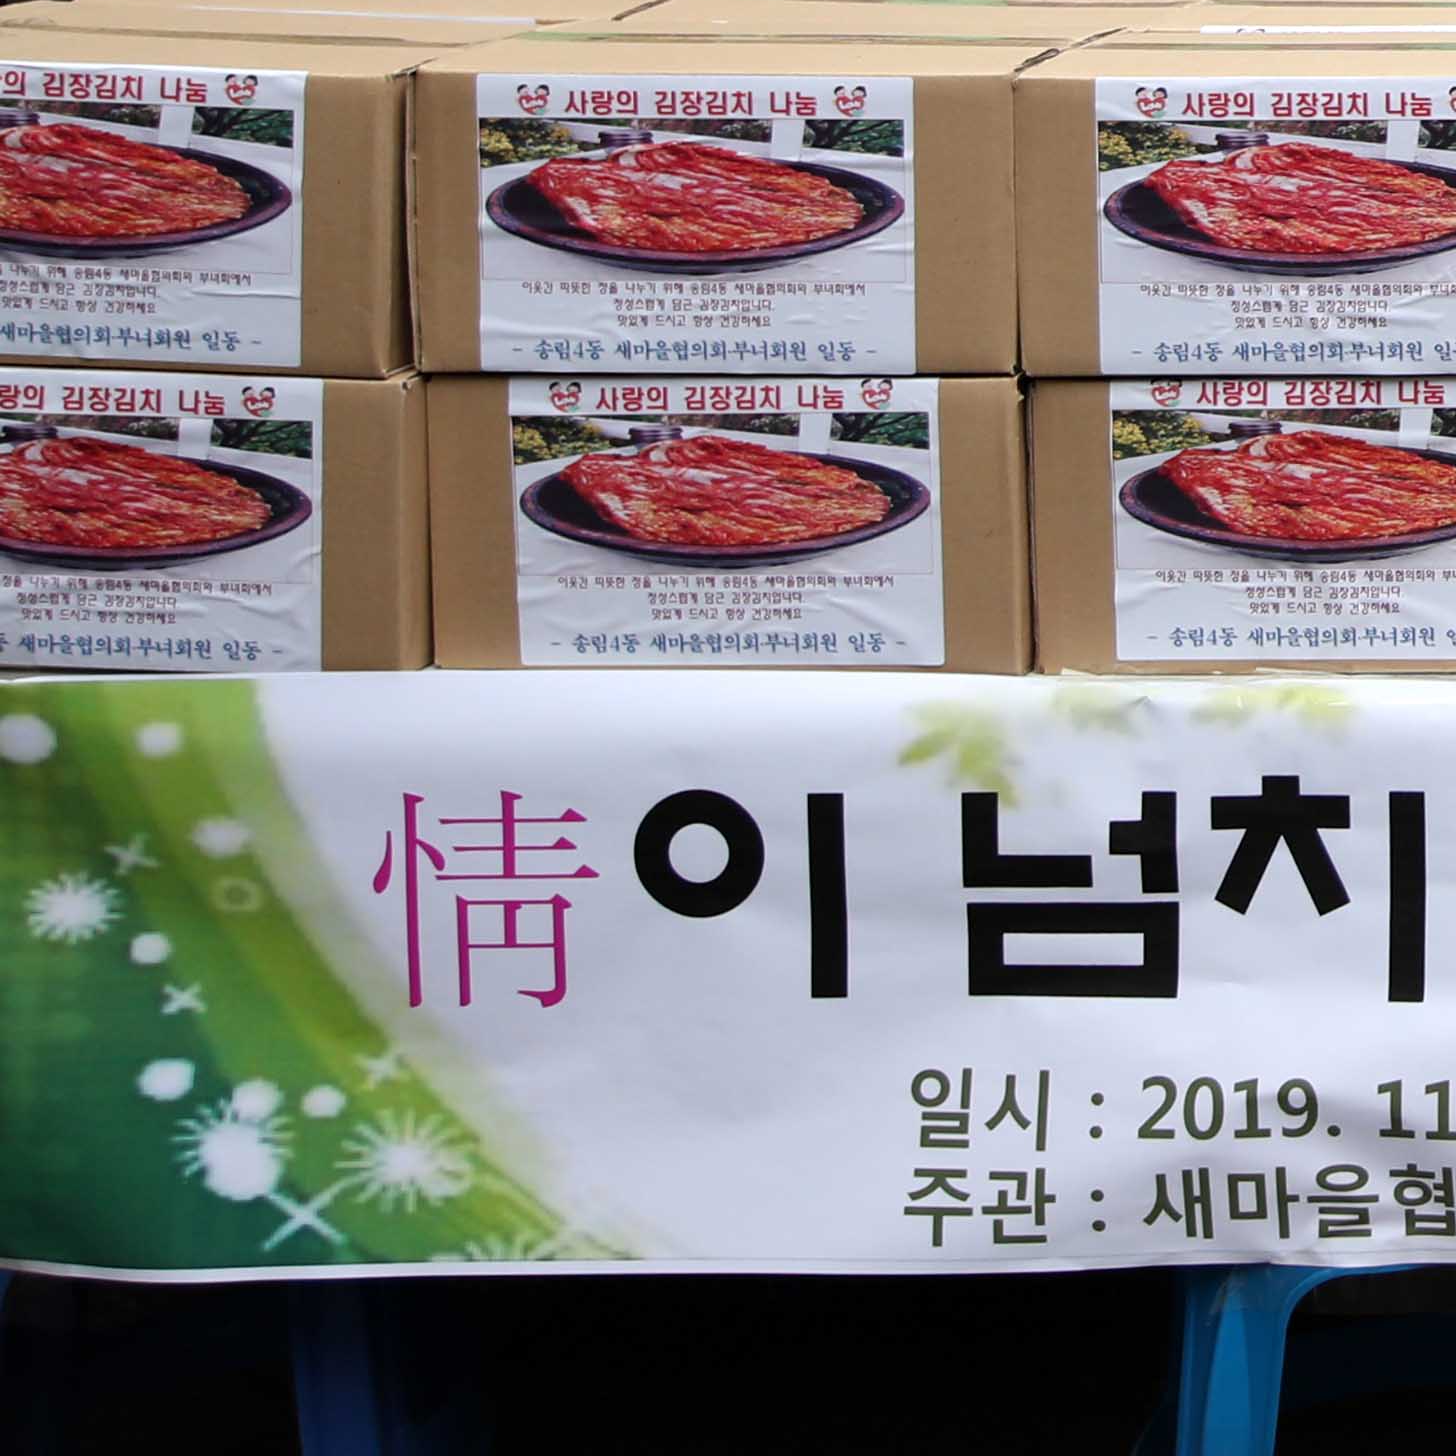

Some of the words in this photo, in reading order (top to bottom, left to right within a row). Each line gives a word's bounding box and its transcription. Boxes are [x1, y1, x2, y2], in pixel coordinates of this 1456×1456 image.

[43, 71, 143, 101] 김장김치
[159, 76, 207, 104] 나눔
[565, 89, 638, 115] 사랑의
[655, 90, 753, 116] 김장김치
[770, 91, 817, 116] 나눔
[1182, 92, 1254, 117] 사랑의
[1271, 92, 1369, 117] 김장김치
[1386, 92, 1432, 117] 나눔
[202, 331, 240, 353] 일동
[535, 340, 604, 361] 송림4동
[818, 342, 856, 363] 일동
[1154, 343, 1222, 363] 송림4동
[0, 382, 45, 410] 랑의
[62, 385, 162, 414] 김장김치
[178, 389, 225, 416] 나눔
[596, 386, 667, 411] 사랑의
[684, 385, 781, 411] 김장김치
[797, 385, 844, 410] 나눔
[1196, 381, 1267, 406] 사랑의
[1285, 380, 1382, 406] 김장김치
[1398, 380, 1444, 405] 나눔
[572, 634, 640, 655] 송림4동
[849, 633, 886, 654] 일동
[1169, 628, 1237, 648] 송림4동
[223, 641, 262, 663] 일동
[373, 789, 849, 1008] 情이
[911, 1069, 1049, 1151] 일시
[1138, 1076, 1341, 1140] 2019.
[904, 1168, 1056, 1247] 주관
